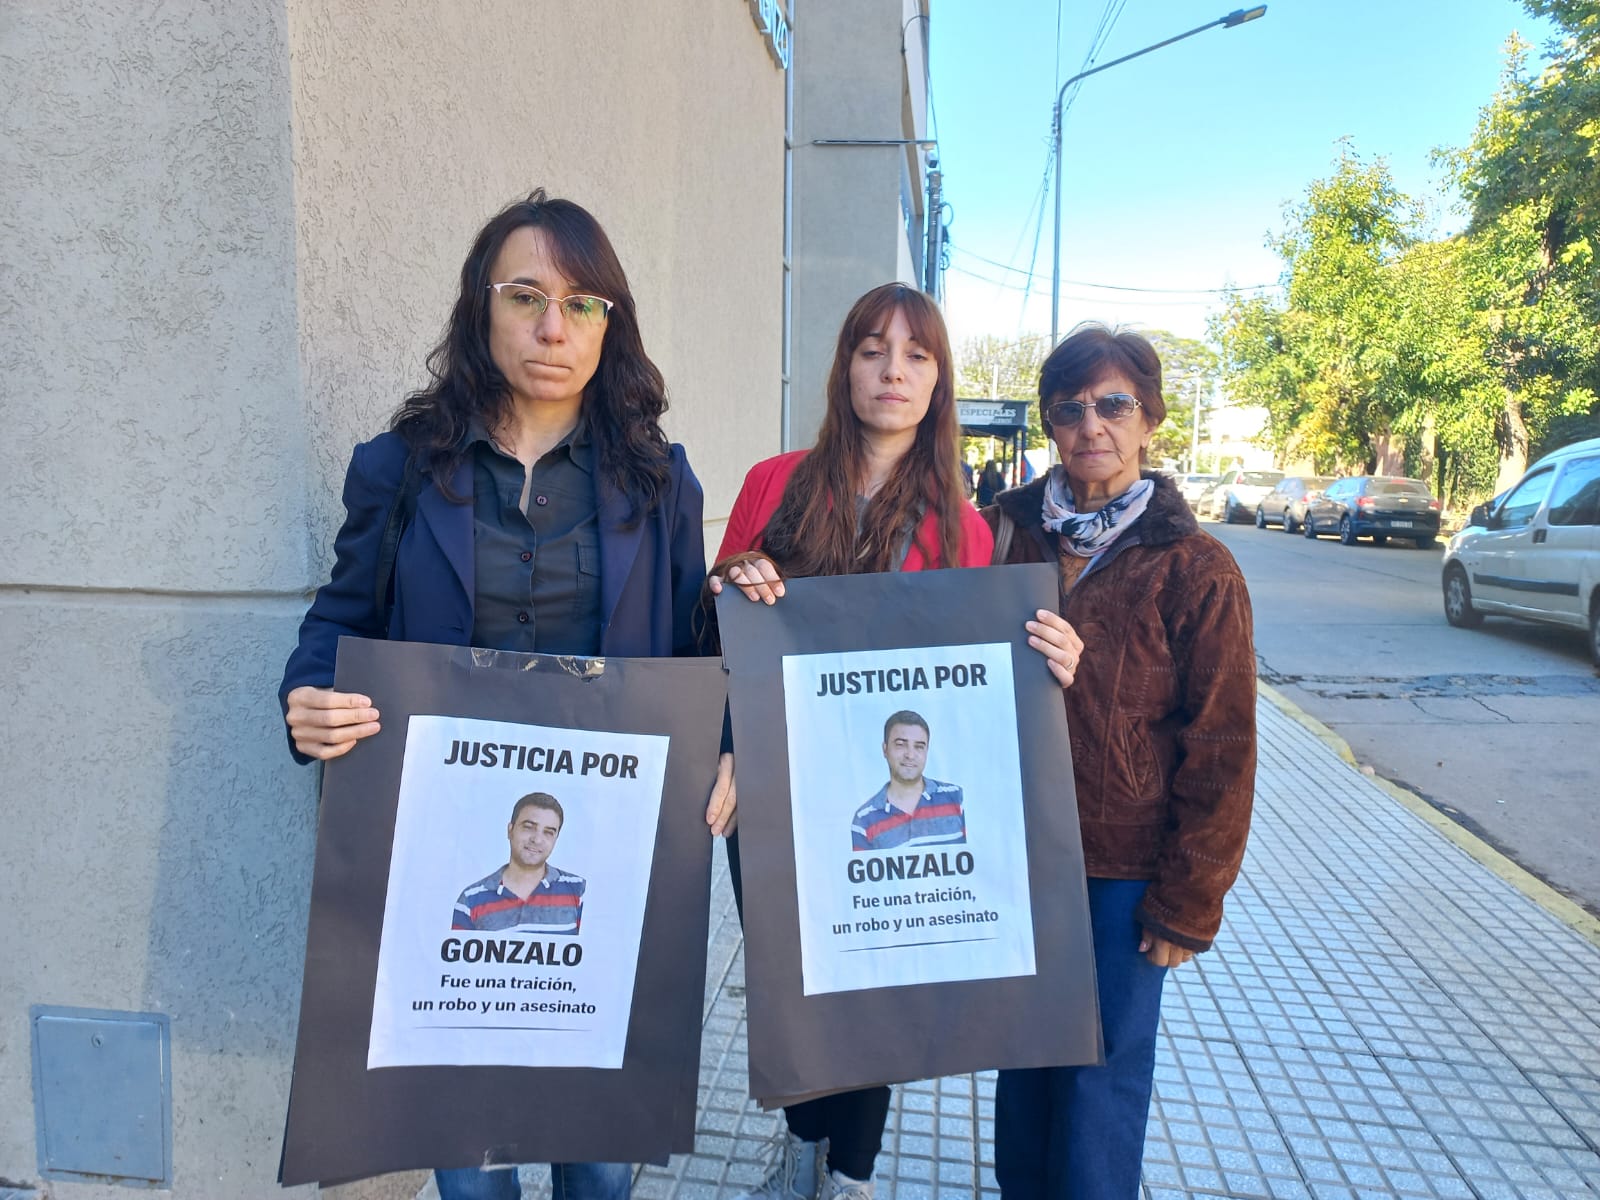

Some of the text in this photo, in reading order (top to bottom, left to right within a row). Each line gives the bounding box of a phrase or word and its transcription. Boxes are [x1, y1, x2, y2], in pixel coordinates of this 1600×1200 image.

[817, 664, 988, 697] JUSTICIA POR
[443, 740, 639, 780] JUSTICIA POR
[847, 851, 975, 884] GONZALO
[852, 887, 977, 909] Fue una traición,
[832, 909, 999, 935] un robo y un asesinato
[440, 937, 583, 967] GONZALO
[440, 974, 577, 994] Fue una traición,
[412, 997, 596, 1015] un robo y un asesinato
